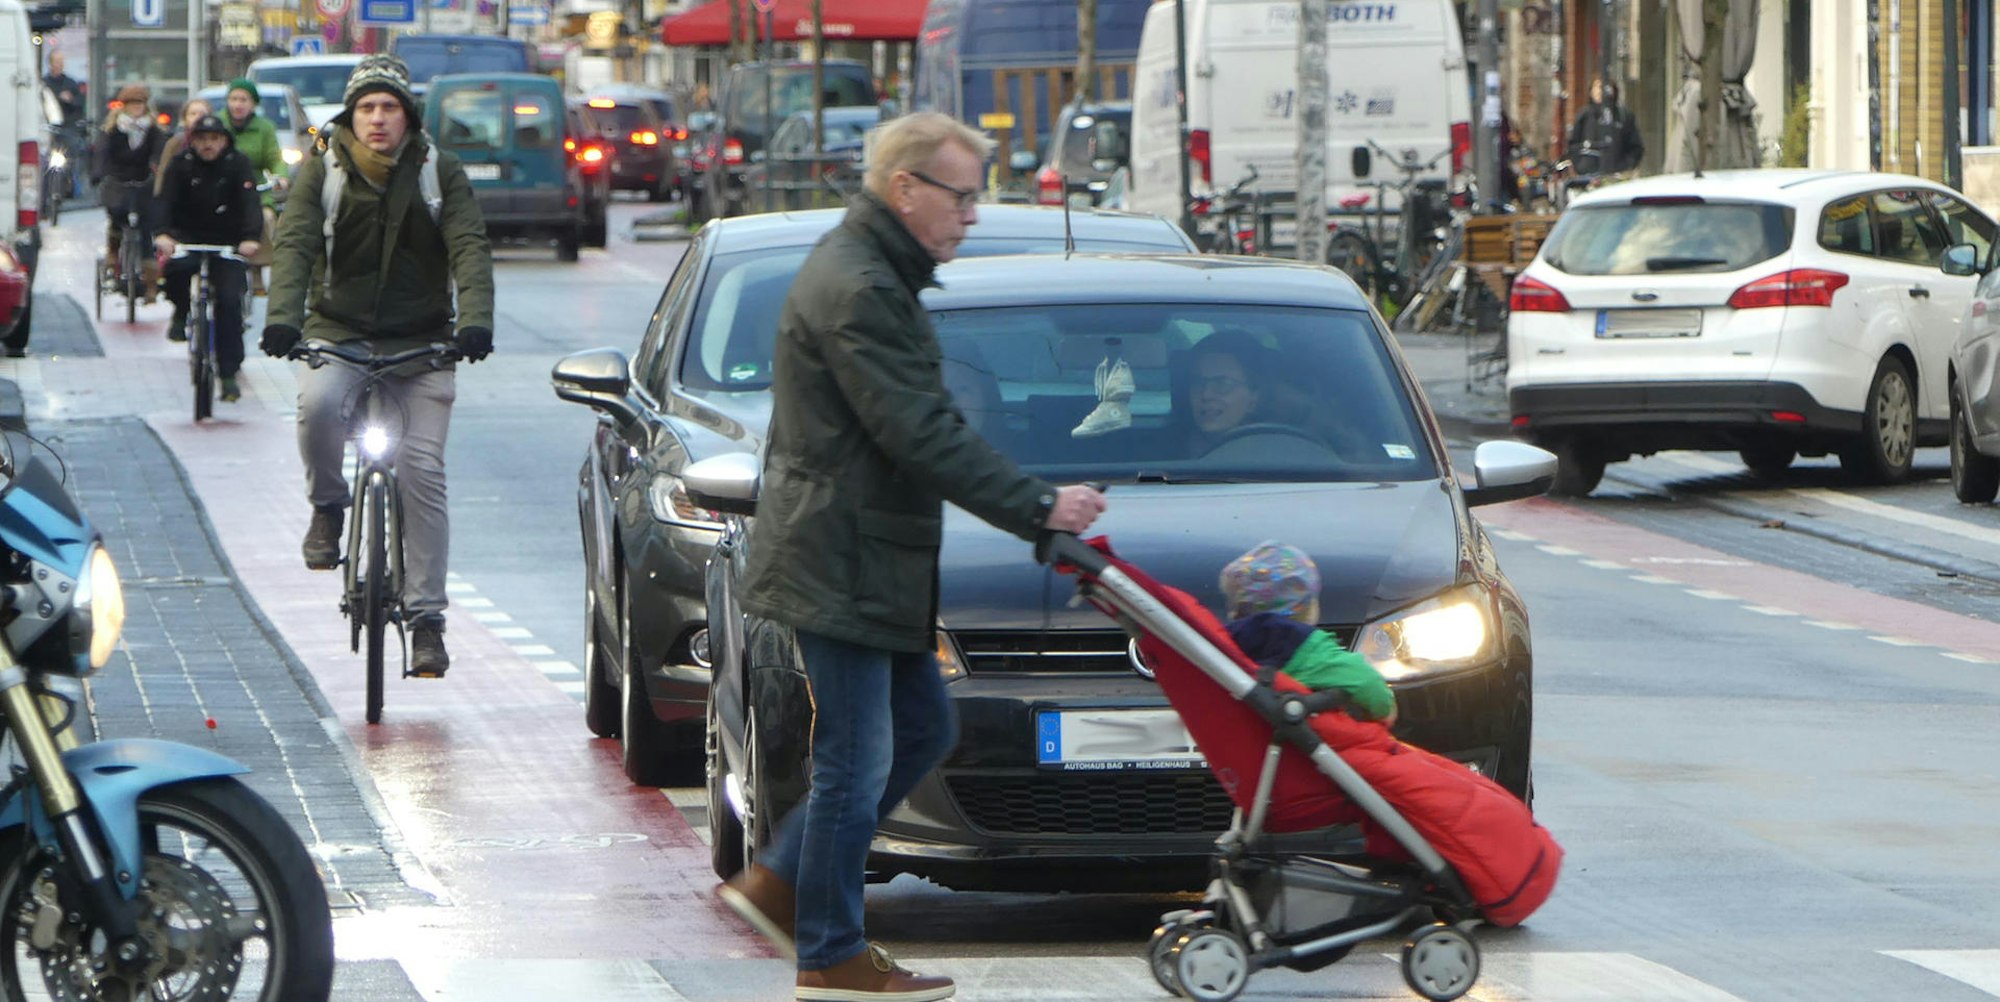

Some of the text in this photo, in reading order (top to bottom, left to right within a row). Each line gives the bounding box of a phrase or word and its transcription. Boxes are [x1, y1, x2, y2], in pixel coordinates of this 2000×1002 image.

[1325, 4, 1396, 22] BOTH
[1045, 741, 1055, 753] D
[1064, 762, 1105, 770] AUTOHAUS
[1136, 761, 1191, 769] HEILIGENHAUS
